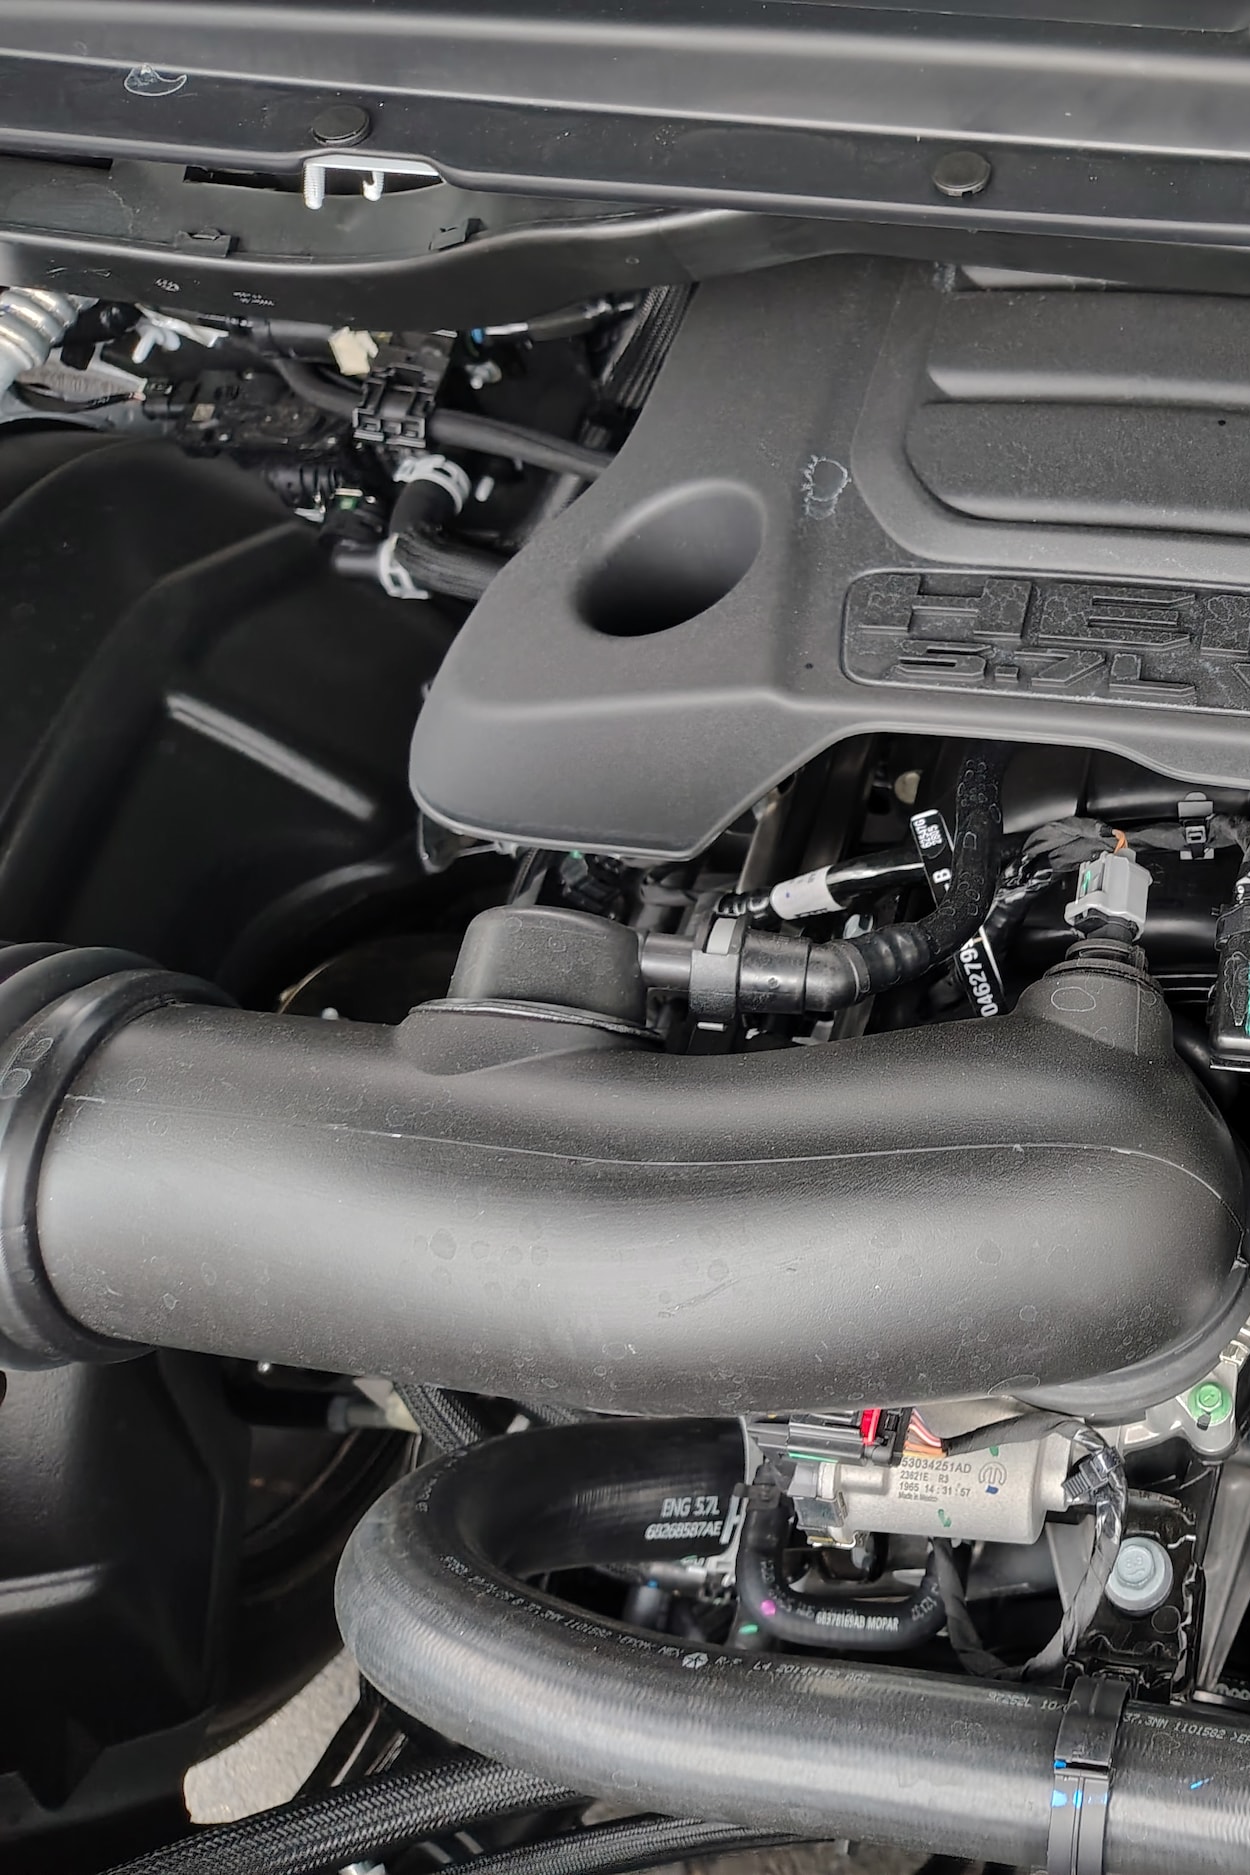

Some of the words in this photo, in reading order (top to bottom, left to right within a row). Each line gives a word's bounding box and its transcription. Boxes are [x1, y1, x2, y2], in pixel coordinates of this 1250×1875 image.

[894, 640, 1196, 696] 5.7L
[901, 1457, 972, 1473] 53034251AD
[898, 1481, 920, 1492] 1965
[937, 1473, 949, 1484] R3
[660, 1496, 692, 1518] ENG
[866, 1615, 900, 1632] MOPAR
[1173, 1720, 1226, 1741] 1101582
